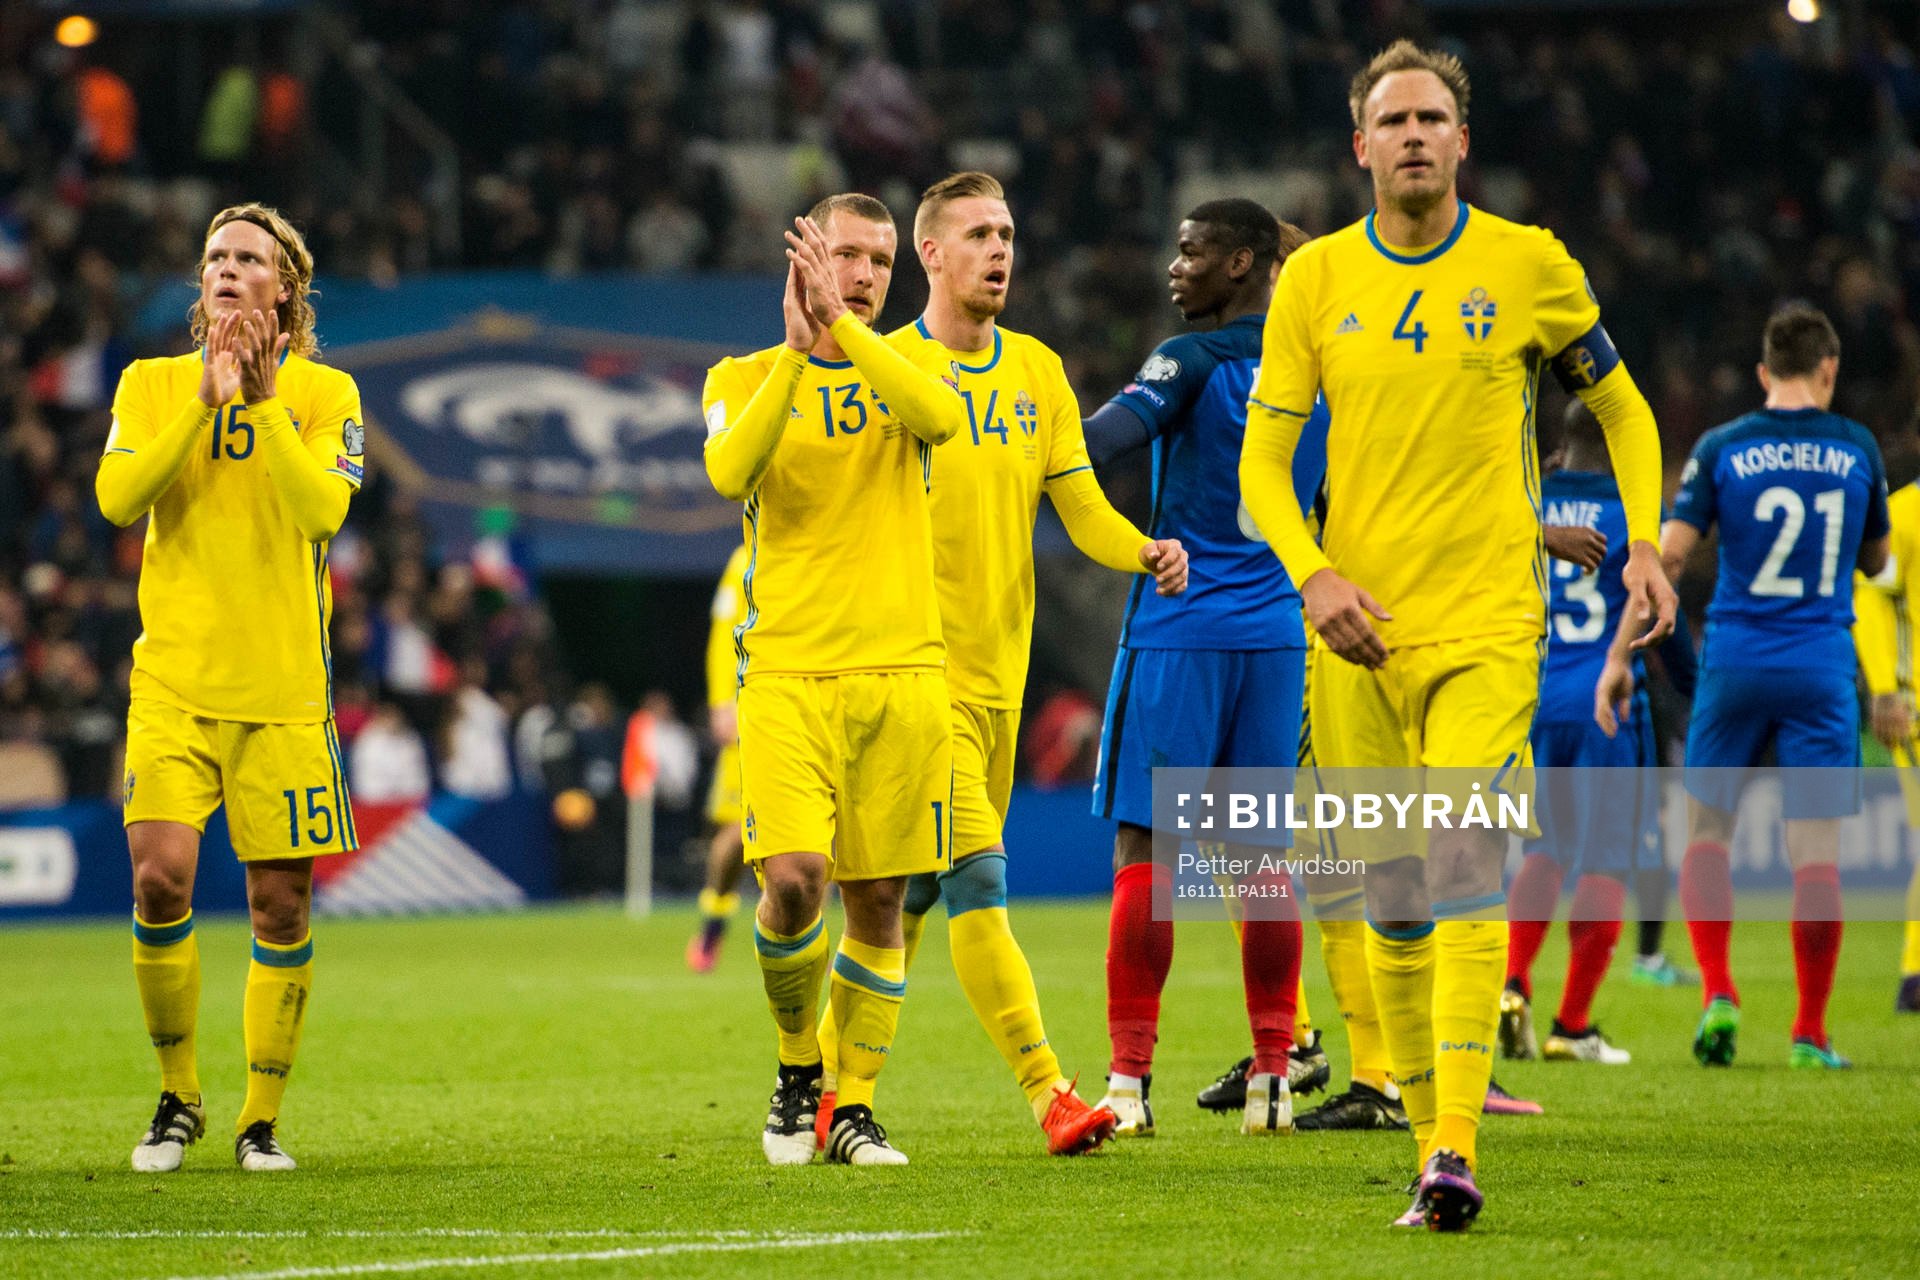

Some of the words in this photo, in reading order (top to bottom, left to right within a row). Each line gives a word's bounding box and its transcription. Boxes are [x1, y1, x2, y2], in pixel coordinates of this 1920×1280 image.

[1392, 289, 1429, 353] 4
[211, 404, 255, 461] 15
[817, 382, 867, 437] 13
[960, 390, 1009, 446] 14
[1730, 443, 1857, 480] KOSCIELNY
[1540, 500, 1603, 529] ANTE
[1749, 485, 1846, 598] 21
[283, 786, 334, 848] 15
